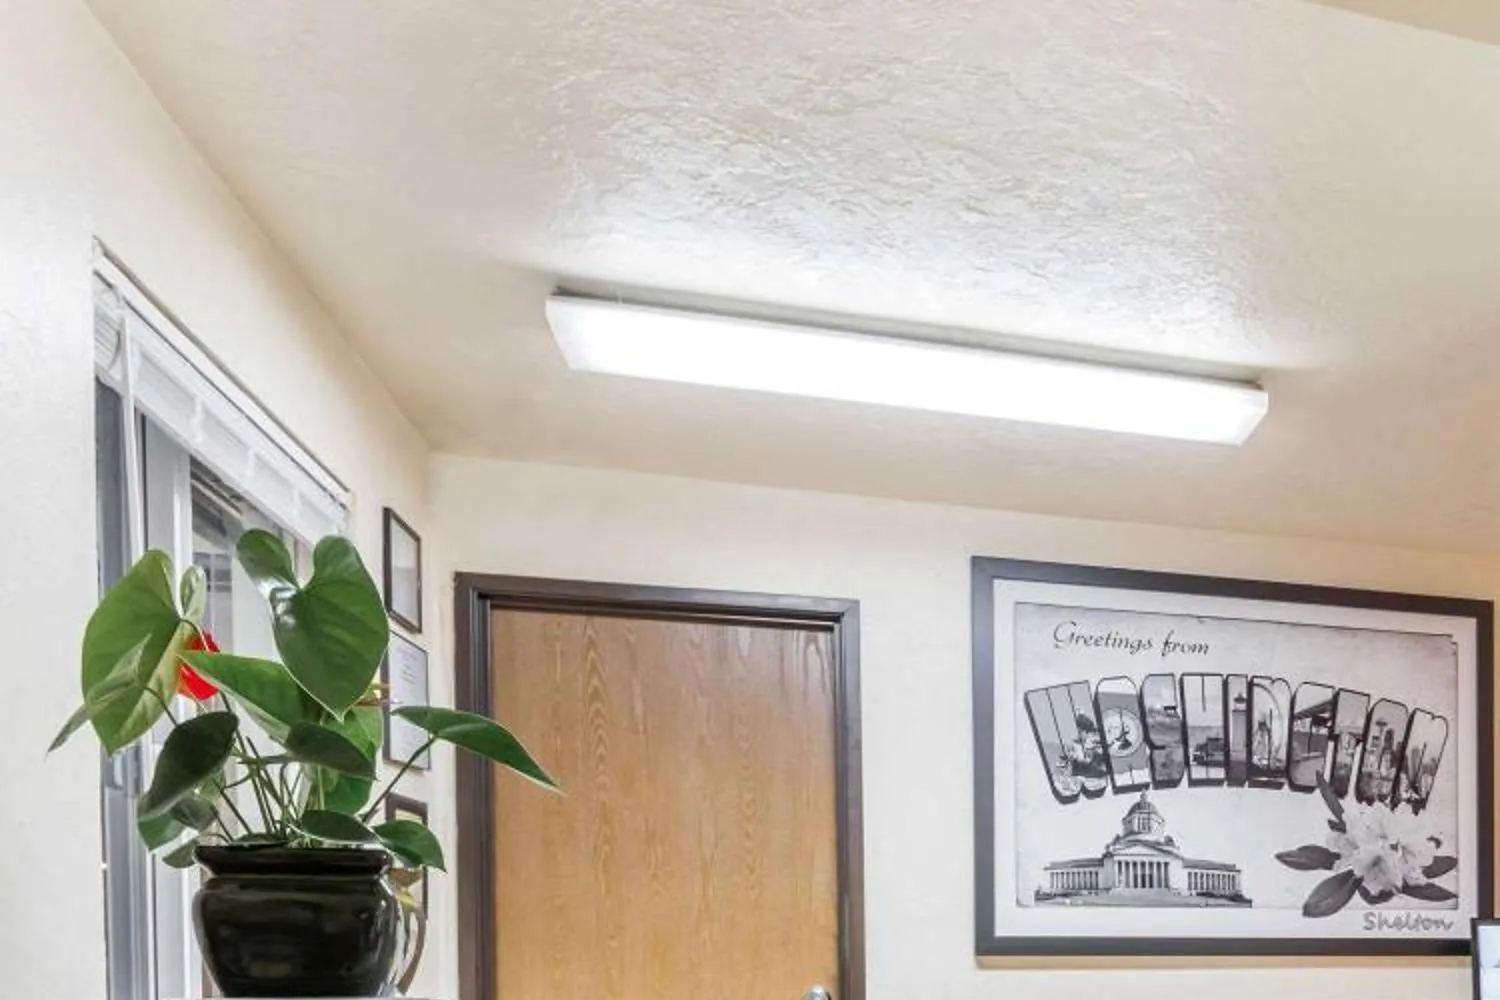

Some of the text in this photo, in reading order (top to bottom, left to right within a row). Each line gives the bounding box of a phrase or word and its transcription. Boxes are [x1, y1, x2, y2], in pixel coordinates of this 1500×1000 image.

[1053, 621, 1209, 658] Greetings from
[1024, 672, 1450, 817] WASHINGTON
[1362, 911, 1454, 931] Shelton
